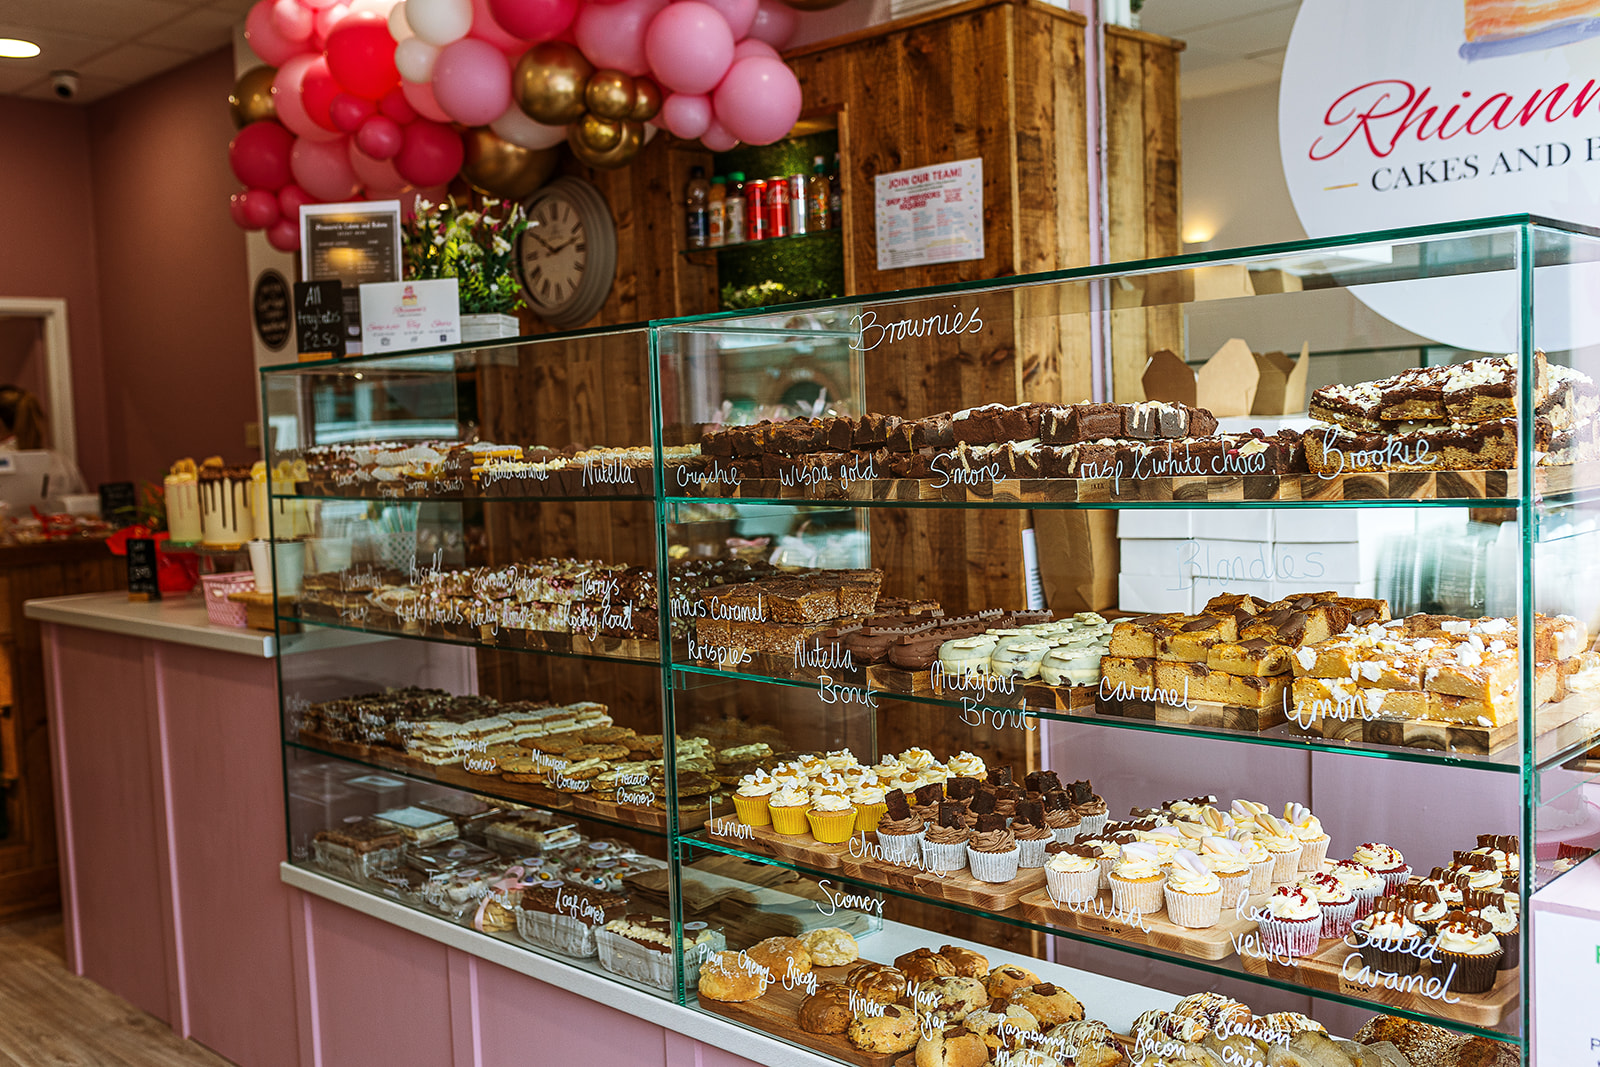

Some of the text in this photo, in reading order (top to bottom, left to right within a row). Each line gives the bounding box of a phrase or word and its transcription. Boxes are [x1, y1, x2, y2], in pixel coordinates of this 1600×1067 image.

[888, 176, 910, 190] JOIN
[911, 172, 930, 186] OUR
[932, 167, 962, 181] TEAM!
[1370, 153, 1480, 192] CAKES
[1489, 140, 1572, 176] AND
[304, 285, 322, 307] All
[848, 304, 984, 351] Brownies
[582, 452, 635, 487] Nutella
[840, 454, 879, 490] gold
[1080, 459, 1124, 495] rasp
[1151, 444, 1208, 476] white
[1211, 440, 1266, 475] choco
[1317, 428, 1438, 480] Brookie
[1166, 540, 1325, 591] Blondies
[575, 569, 620, 609] Terry's
[711, 592, 766, 623] Caramel
[563, 599, 634, 642] Rocky Road
[794, 637, 858, 673] Nutella
[817, 675, 879, 708] Bronut
[930, 659, 1018, 702] Milkybar
[1099, 675, 1198, 712] Caramel
[959, 697, 1037, 731] Bronut
[708, 795, 756, 840] Lemon
[848, 829, 948, 879] Chocolate
[816, 879, 886, 917] Scones
[1236, 887, 1282, 924] Red
[697, 942, 728, 974] Plain
[1343, 919, 1446, 964] Salted
[1342, 951, 1460, 1004] Caramel
[848, 989, 887, 1020] Kinder
[906, 980, 943, 1017] Mars
[920, 1013, 948, 1042] Bar
[996, 1012, 1078, 1063] Raspberry
[1124, 1027, 1188, 1066] Bacon
